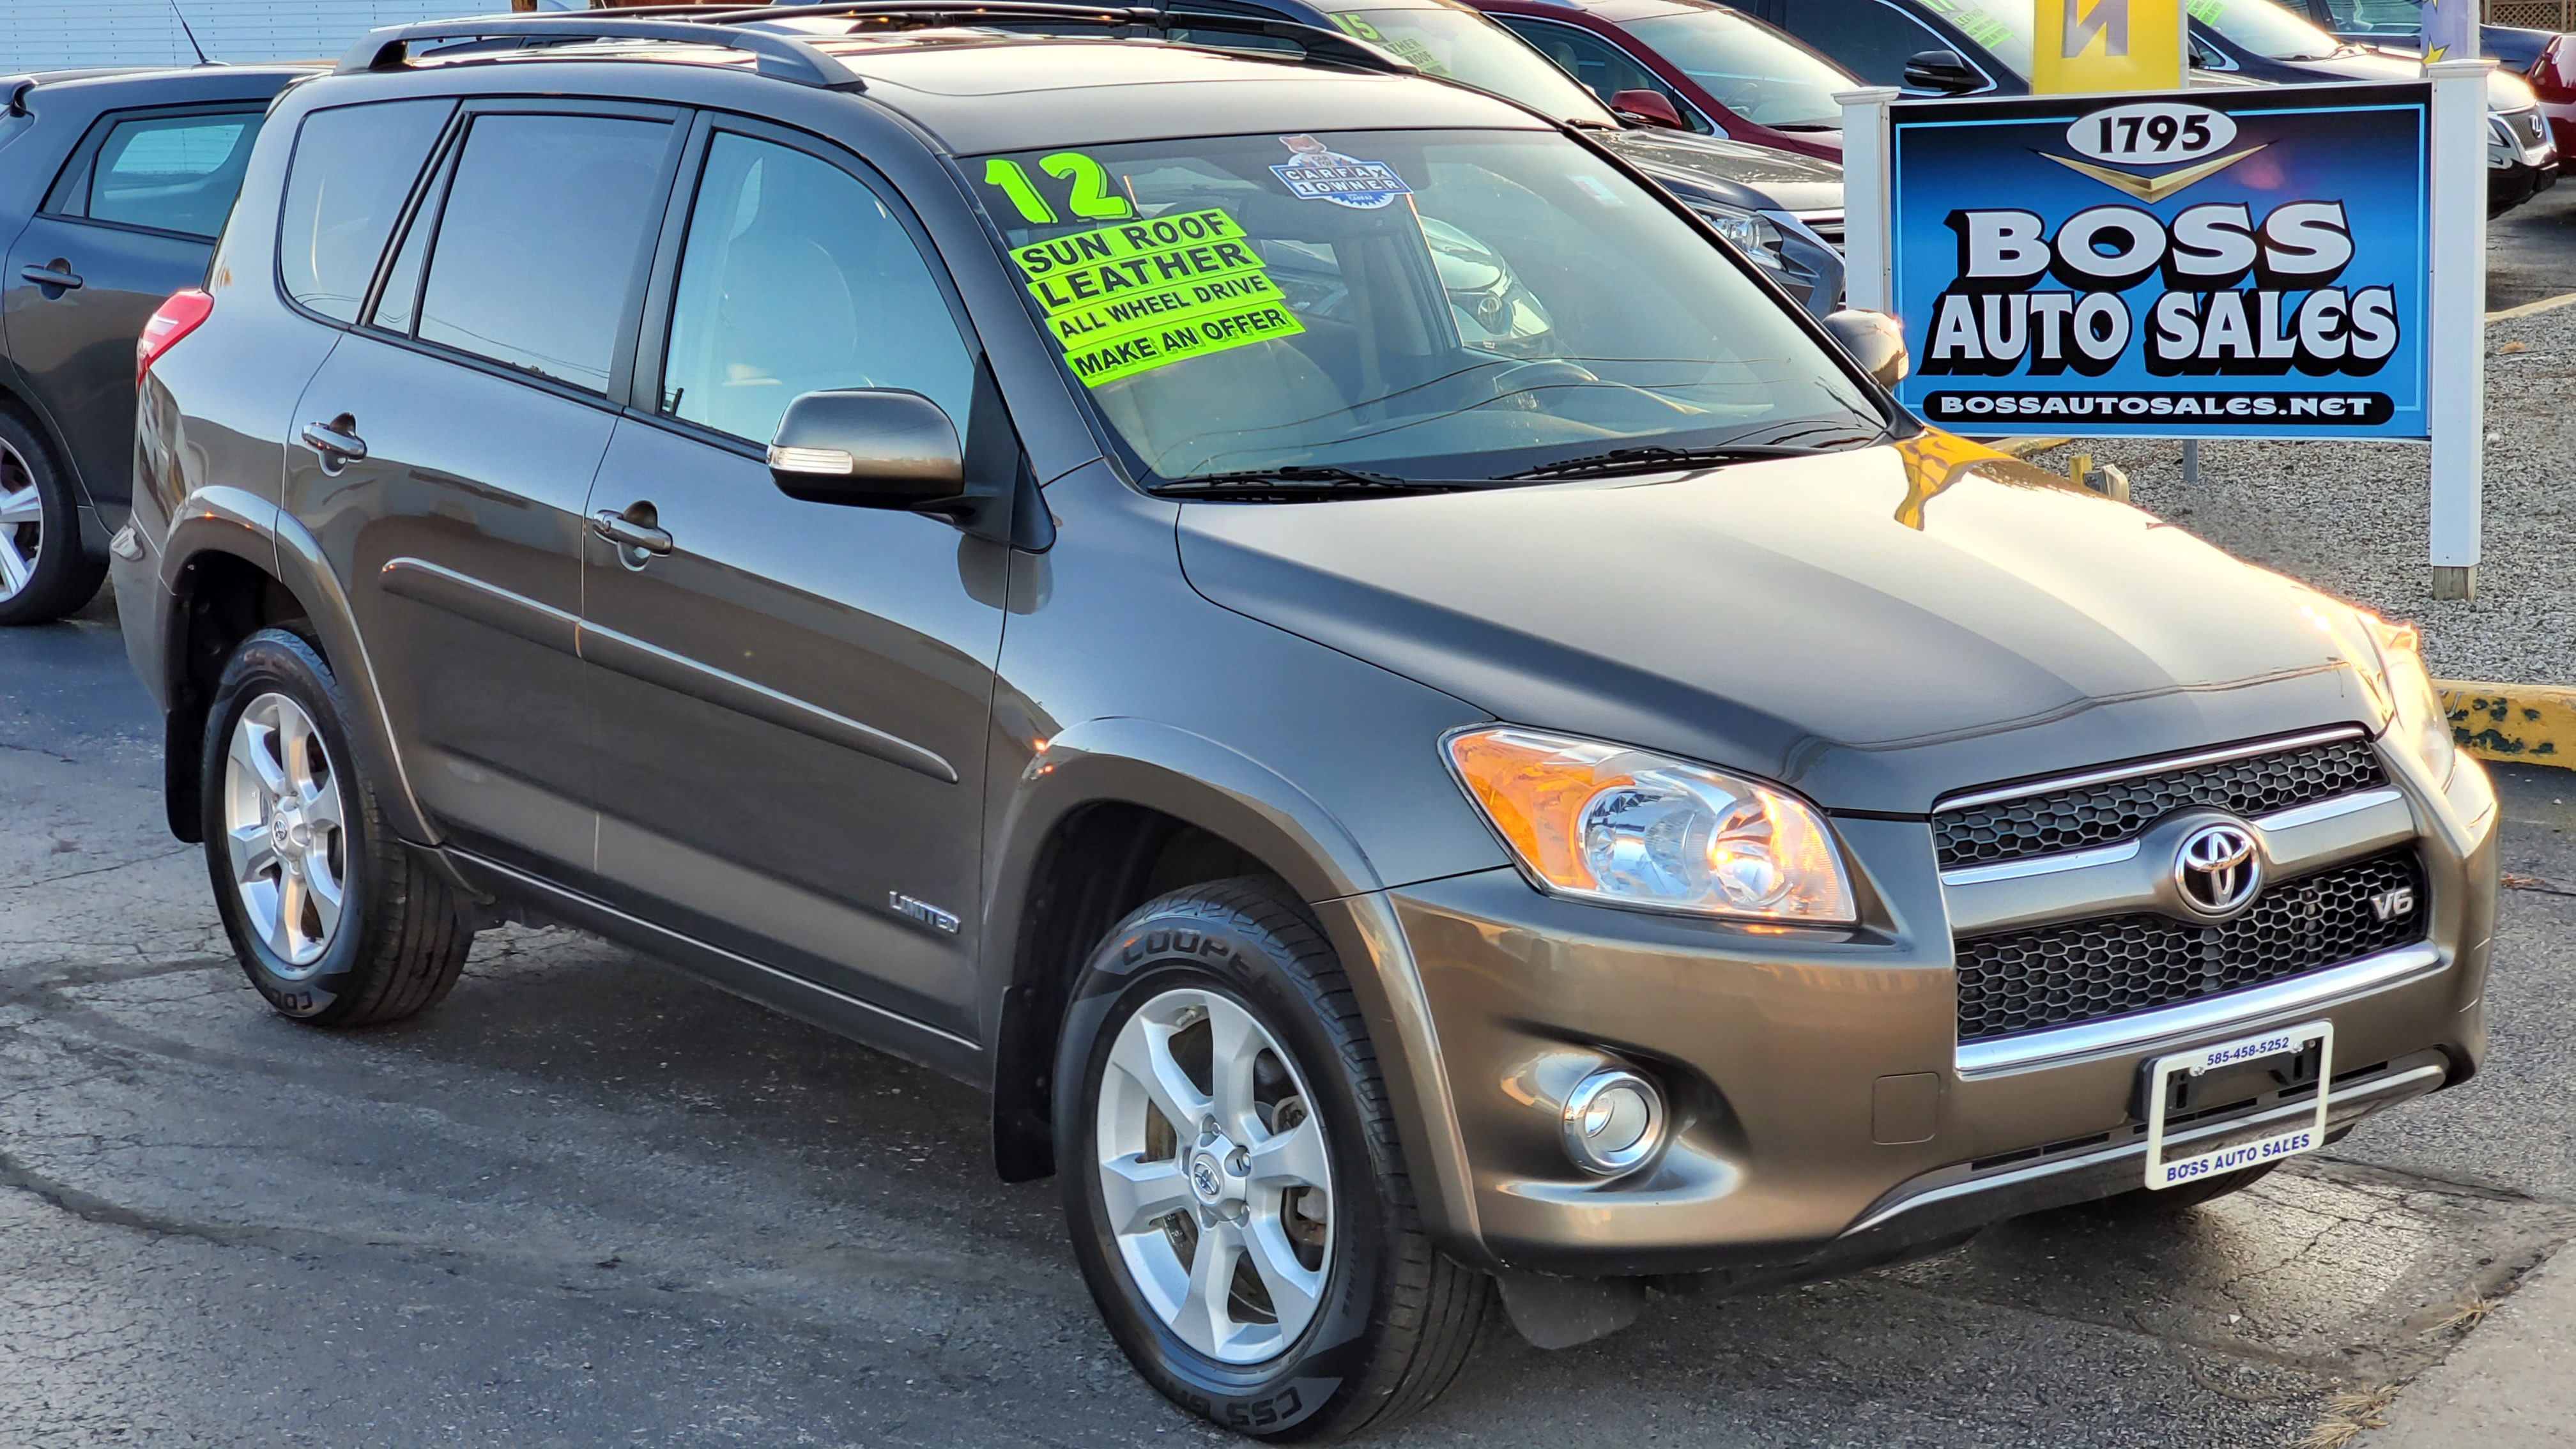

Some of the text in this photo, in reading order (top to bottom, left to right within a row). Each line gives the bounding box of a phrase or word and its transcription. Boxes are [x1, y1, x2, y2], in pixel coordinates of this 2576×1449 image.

[1329, 13, 1379, 40] 15
[1382, 38, 1422, 54] ATHER
[1405, 50, 1434, 65] ROOF
[2098, 113, 2212, 154] 1795
[984, 152, 1133, 224] 12
[1285, 167, 1388, 180] CARFAX
[1299, 179, 1400, 193] 1 OWNER
[1022, 212, 1227, 273] SUN ROOF
[1961, 199, 2354, 280] BOSS
[1038, 242, 1254, 309] LEATHER
[1059, 275, 1269, 339] ALL WHEEL DRIVE
[1930, 288, 2399, 360] AUTO SALES
[1073, 308, 1287, 377] MAKE AN OFFER
[1940, 396, 2372, 417] BOSSAUTOSALES.NET
[2370, 887, 2413, 920] V6
[2206, 1036, 2289, 1066] 585-458-5252
[2166, 1133, 2310, 1181] BOSS AUTO SALES
